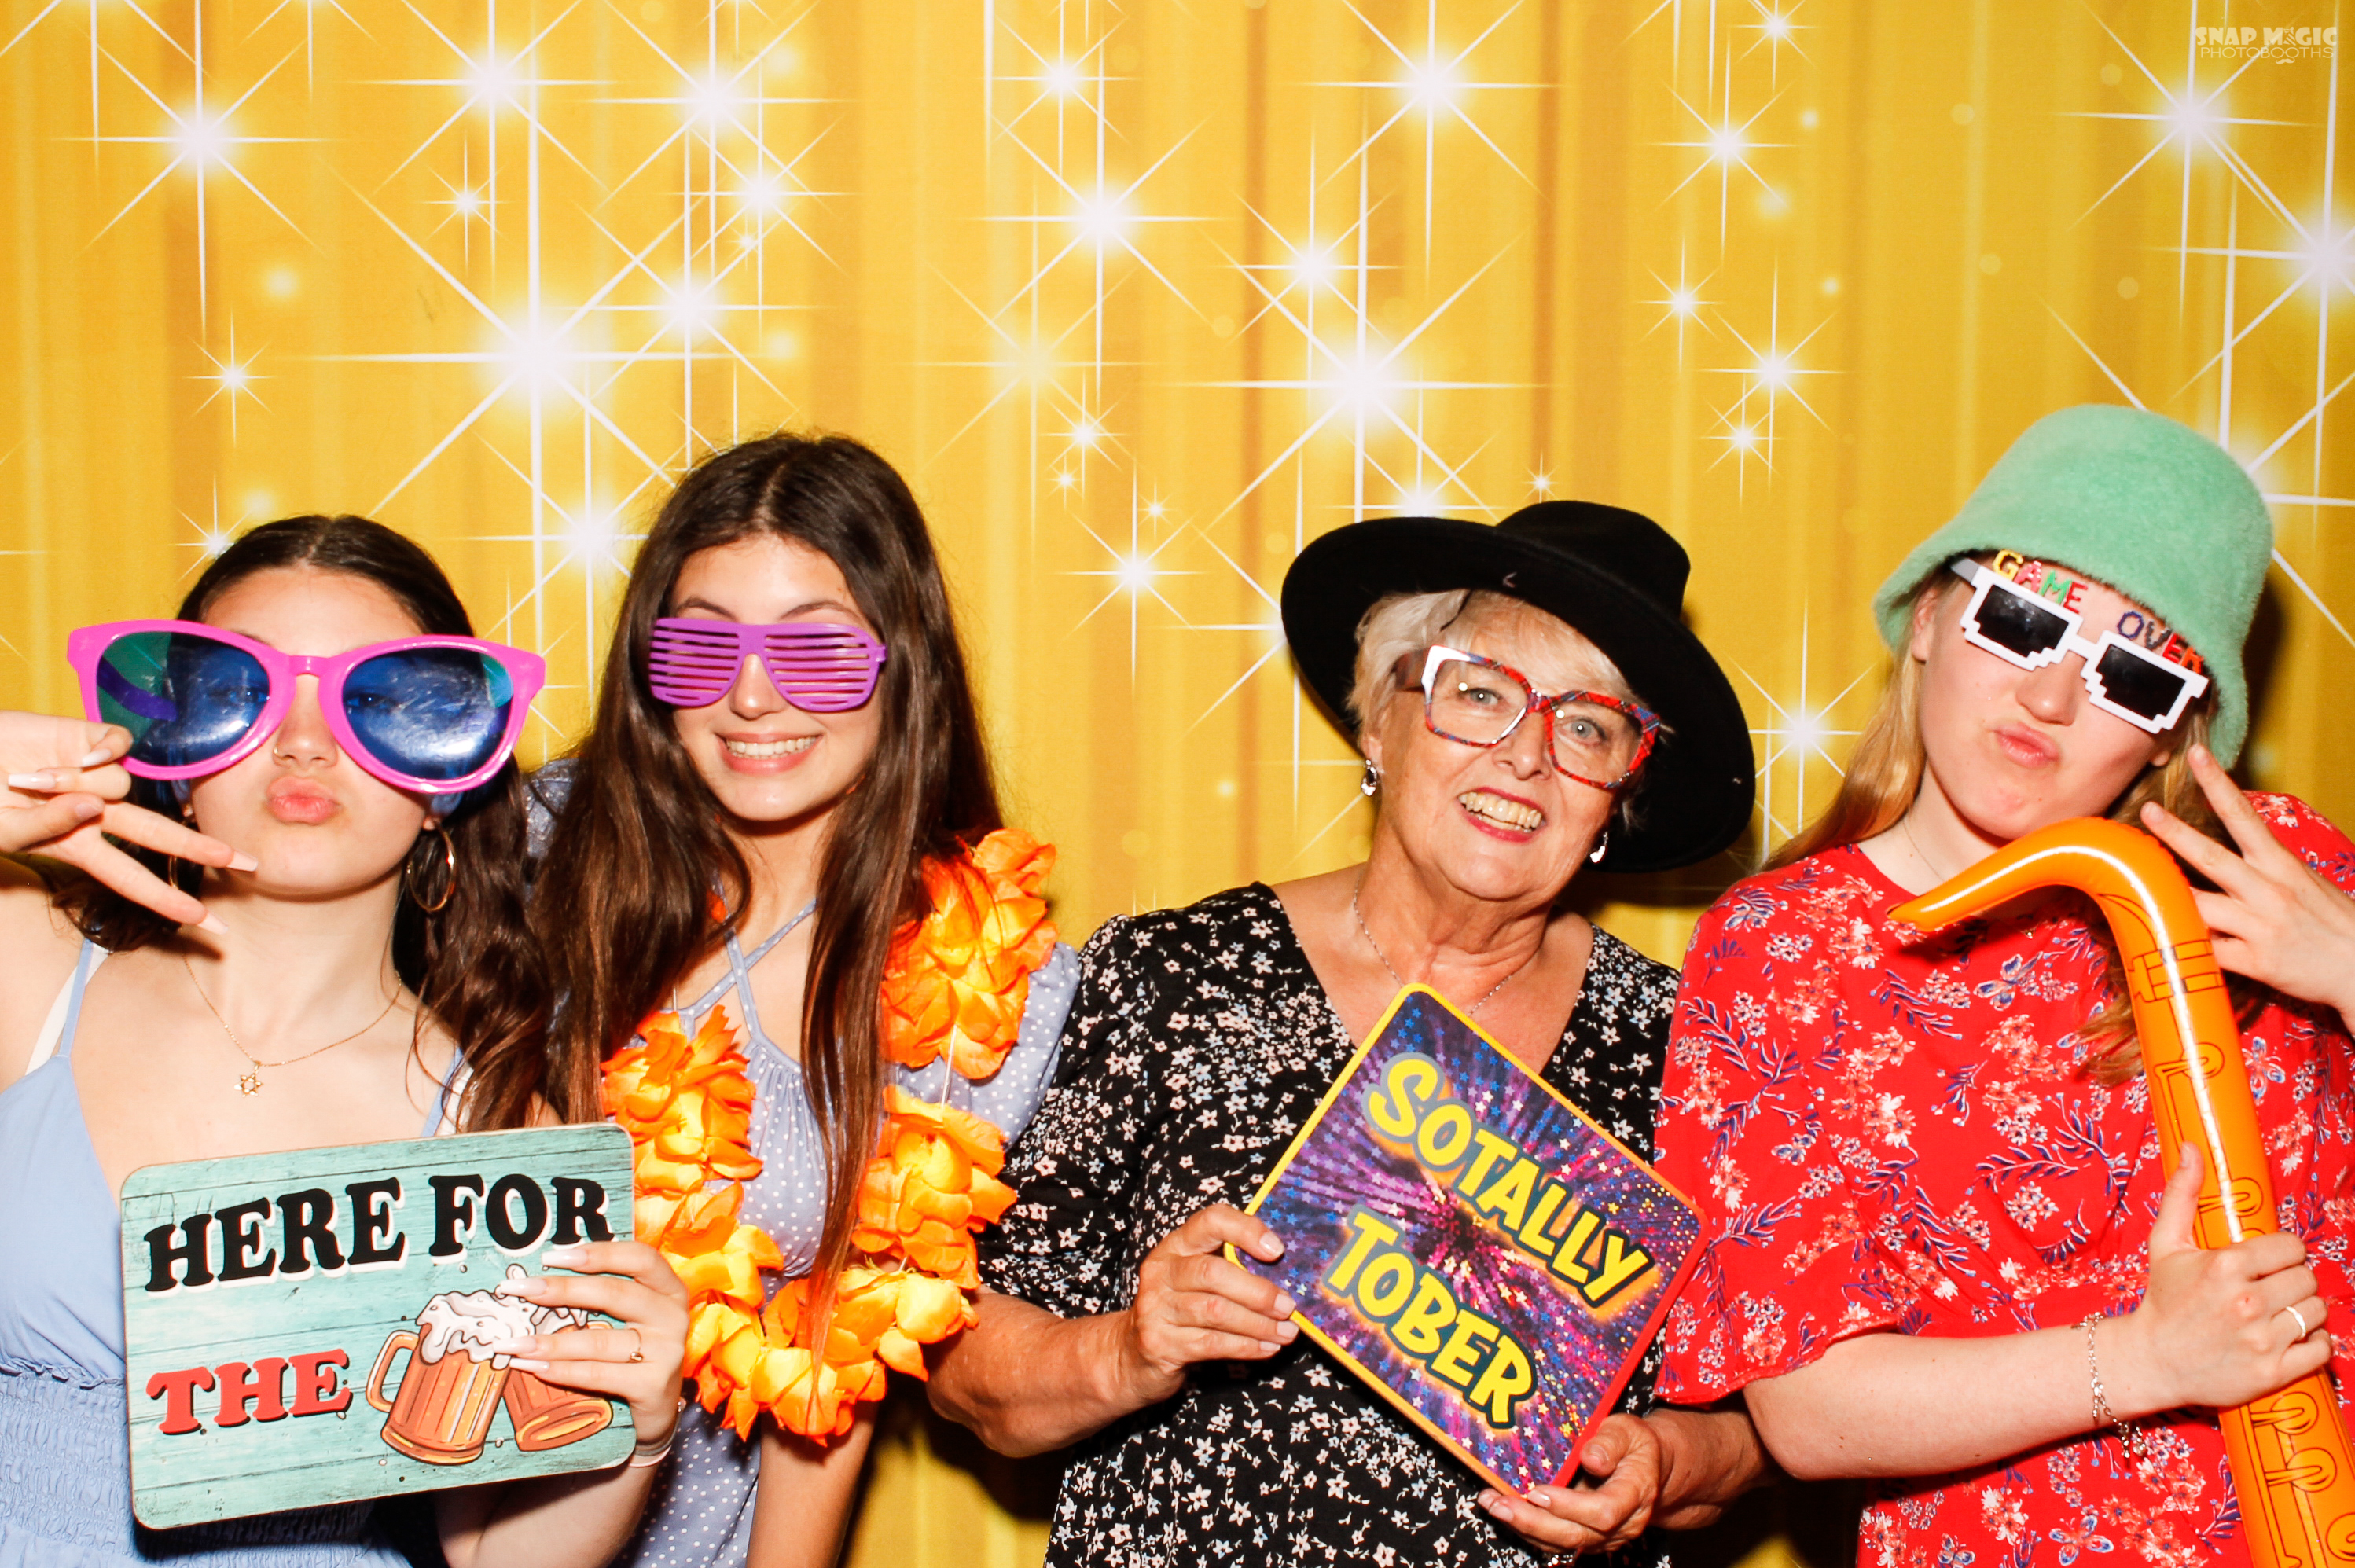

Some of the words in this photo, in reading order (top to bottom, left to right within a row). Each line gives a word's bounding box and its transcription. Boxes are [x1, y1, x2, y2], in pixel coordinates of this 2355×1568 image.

[1993, 549, 2088, 615] GAME
[144, 1177, 406, 1293] HERE
[428, 1174, 615, 1261] FOR
[1365, 1053, 1652, 1305] SOTALLY
[1324, 1206, 1536, 1427] TOBER
[146, 1350, 352, 1434] THE
